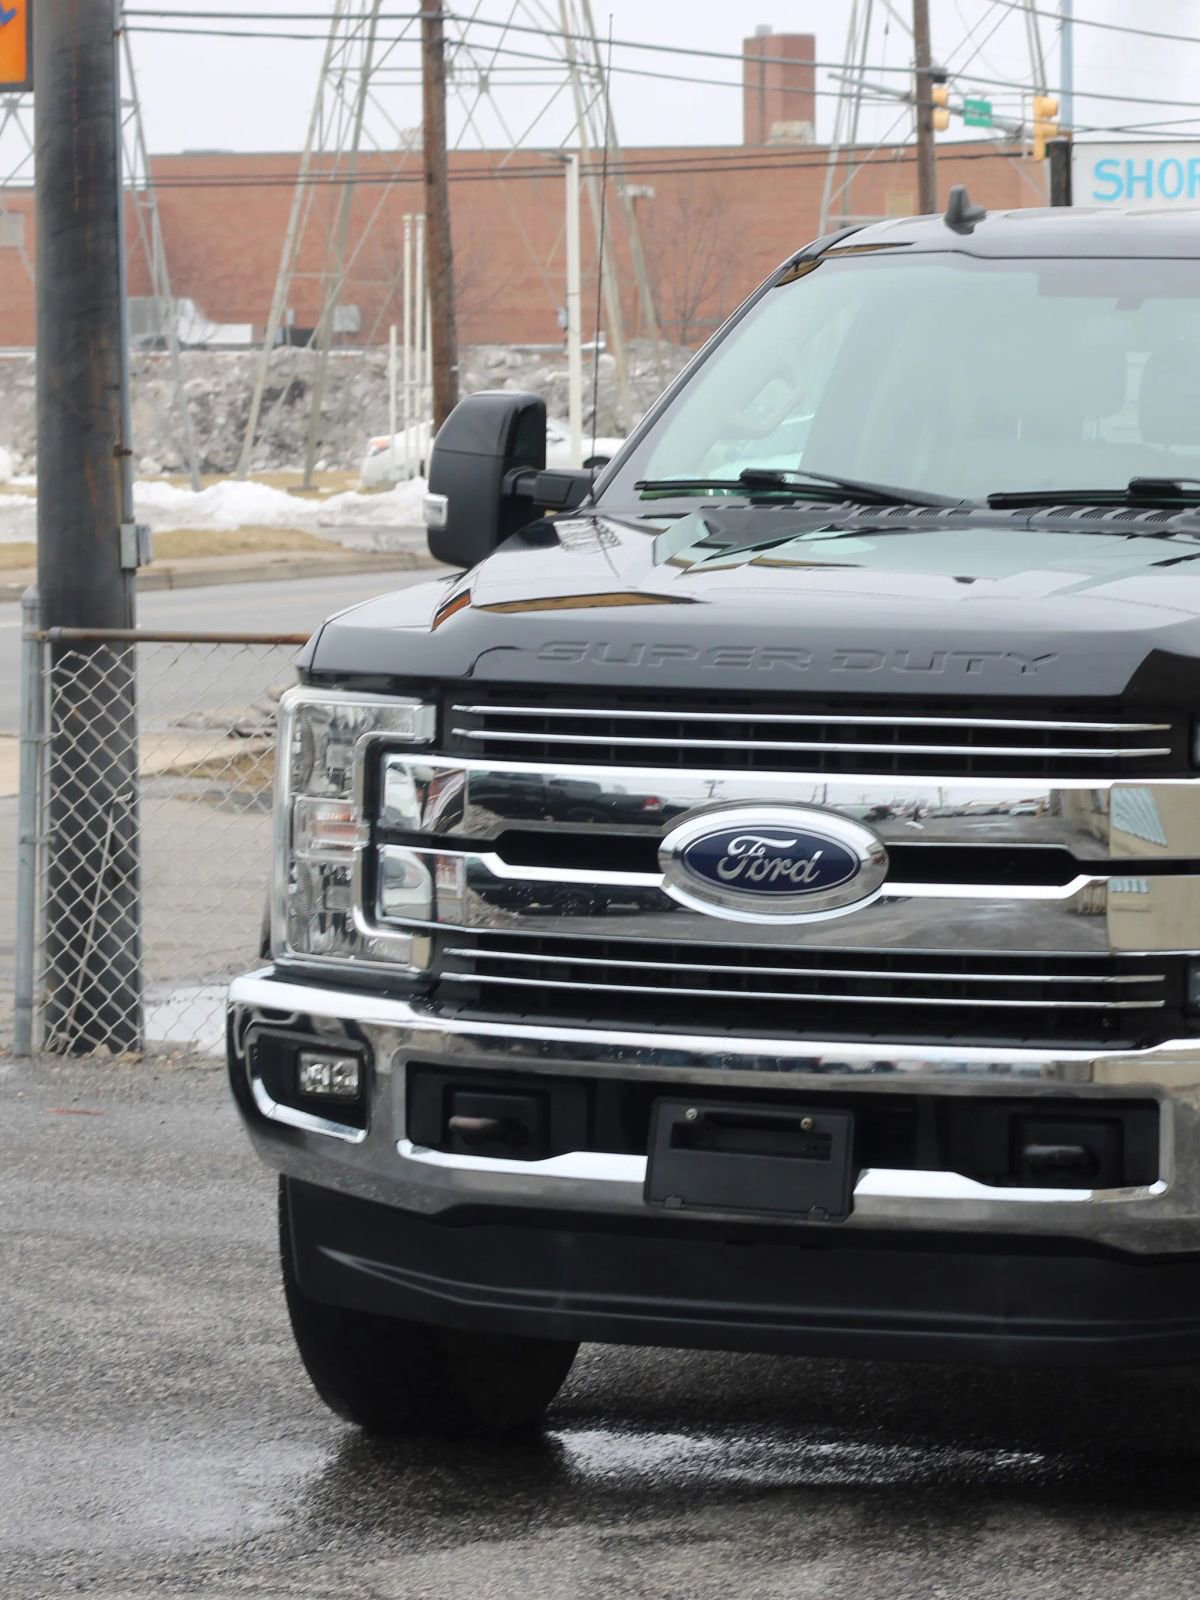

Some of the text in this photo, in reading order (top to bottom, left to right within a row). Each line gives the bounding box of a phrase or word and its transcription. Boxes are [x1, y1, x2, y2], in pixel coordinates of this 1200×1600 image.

[536, 640, 1058, 675] SUPER DUTY
[716, 834, 824, 884] Ford
